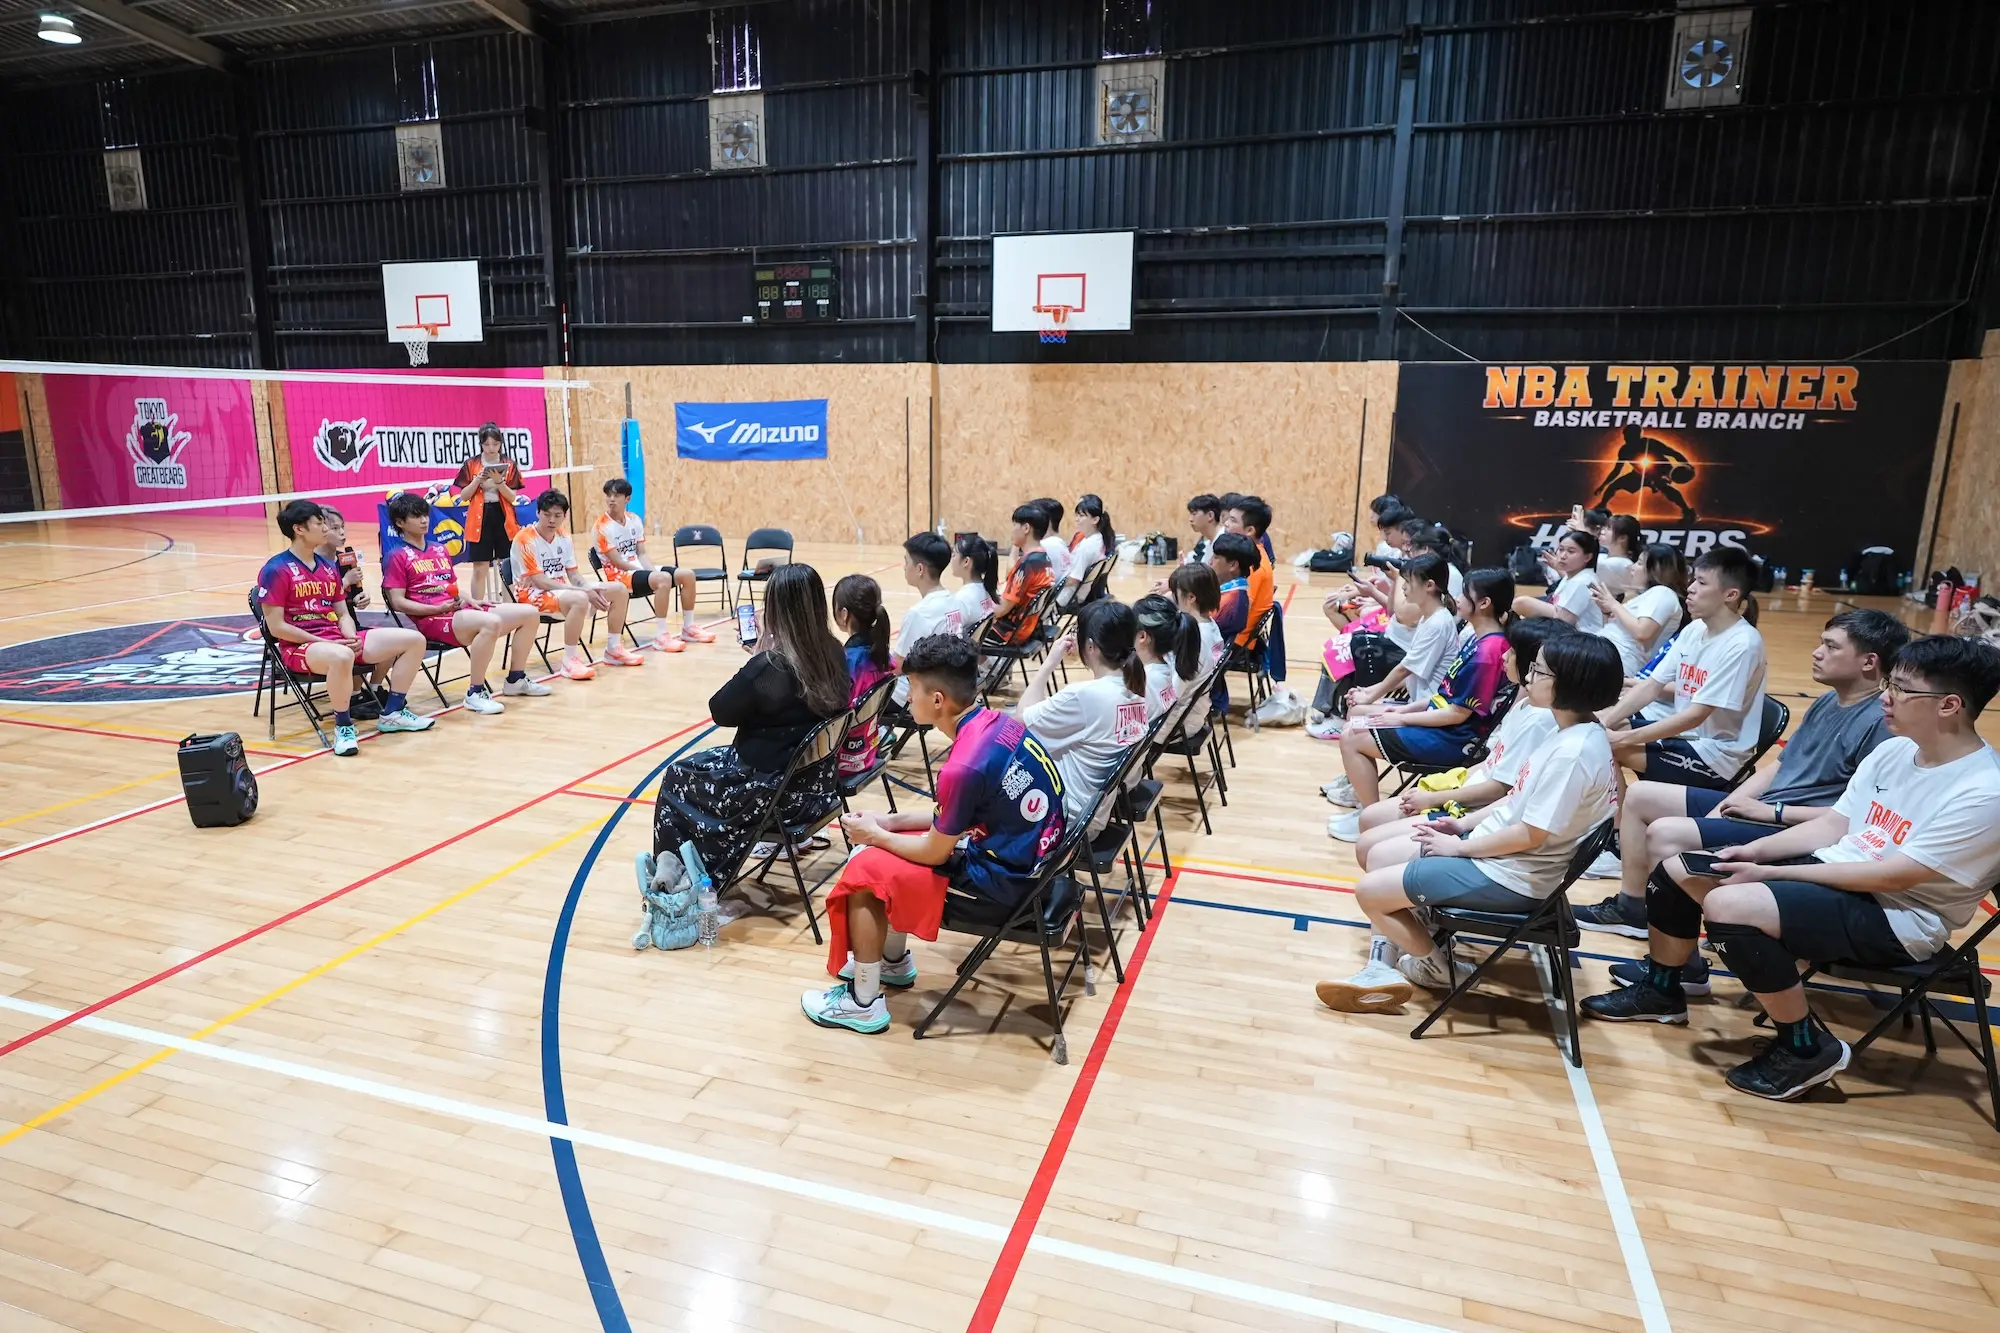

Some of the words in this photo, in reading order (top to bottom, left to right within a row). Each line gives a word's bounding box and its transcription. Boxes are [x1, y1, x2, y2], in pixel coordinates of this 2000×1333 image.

[1482, 365, 1594, 409] NBA
[1604, 365, 1861, 411] TRAINER
[138, 401, 166, 420] TOKYO
[1533, 410, 1687, 429] BASKETBALL
[1696, 411, 1806, 431] BRANCH
[728, 422, 820, 444] MIZUNO
[376, 430, 428, 464] TOKYO
[136, 466, 184, 485] GREATBEARS
